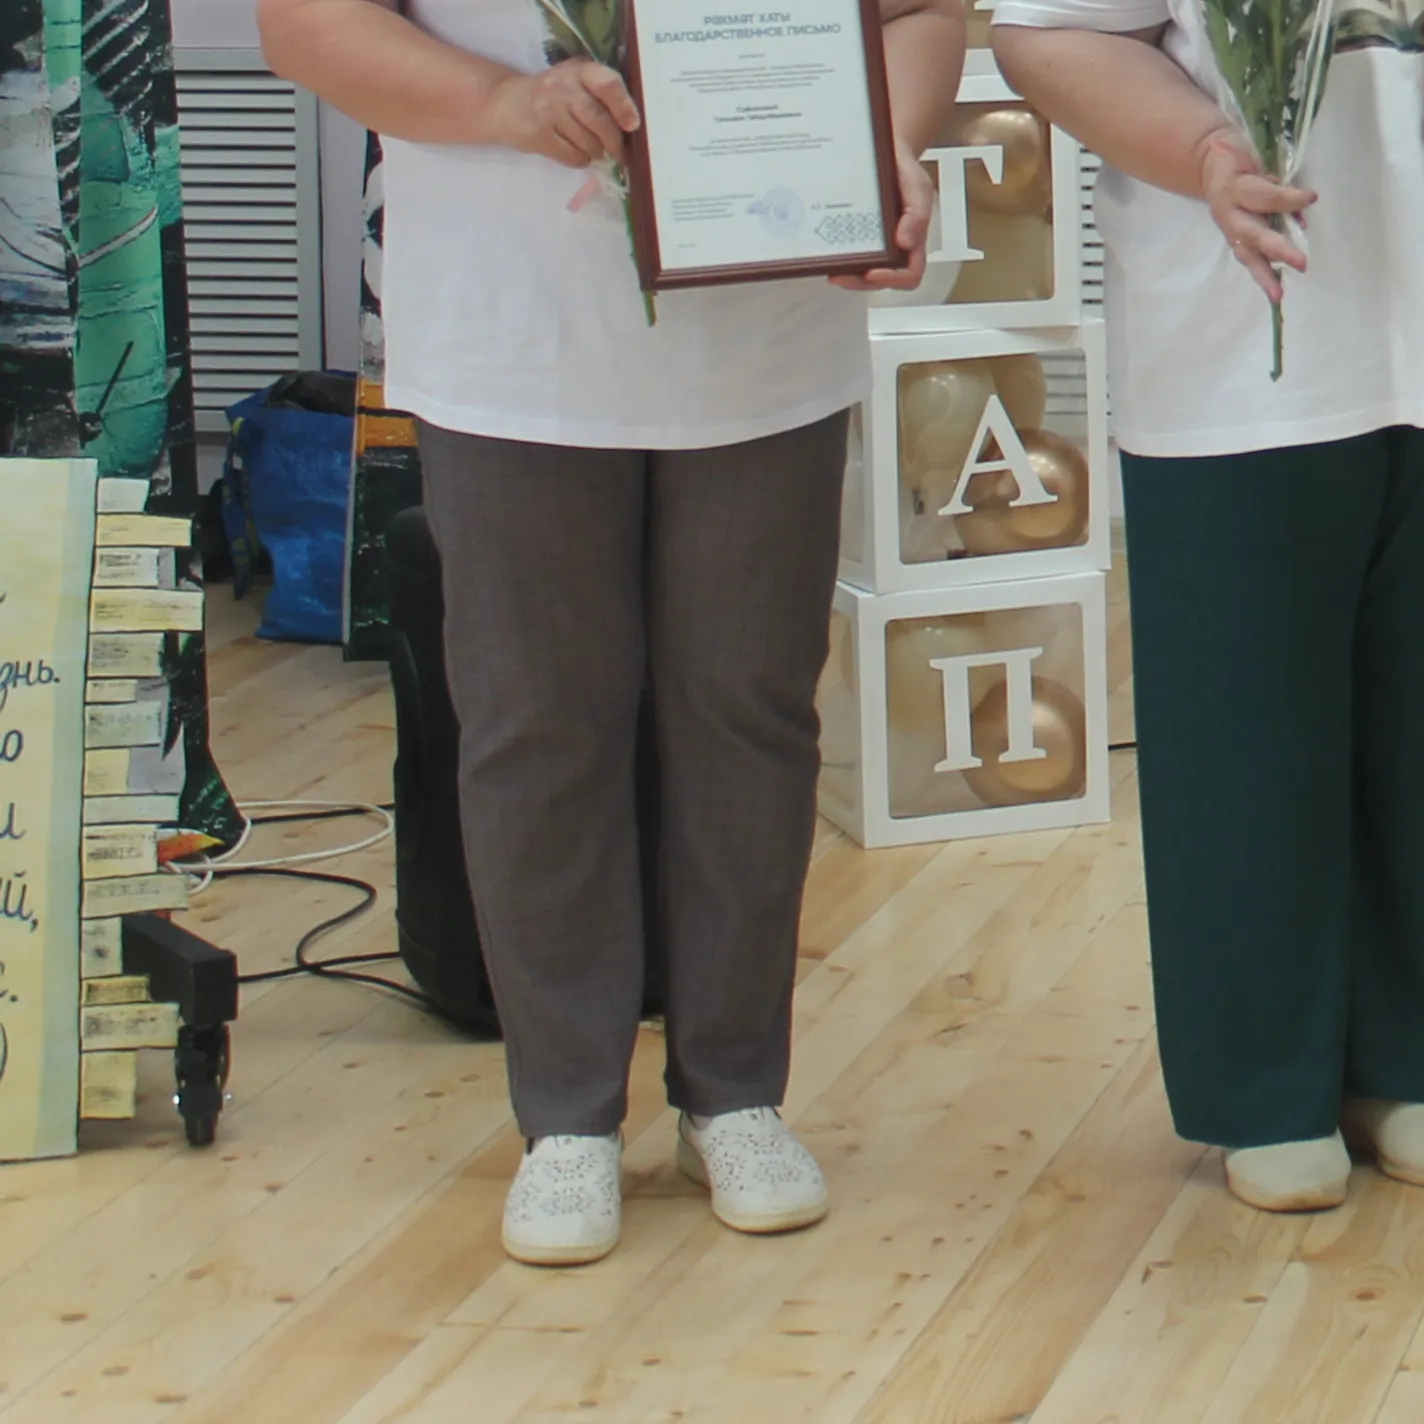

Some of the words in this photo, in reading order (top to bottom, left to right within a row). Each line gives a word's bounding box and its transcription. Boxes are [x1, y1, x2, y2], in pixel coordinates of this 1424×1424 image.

[655, 25, 785, 44] БЛАГОДАРСТВЕННОЕ
[938, 394, 1058, 516] А
[929, 647, 1047, 773] П
